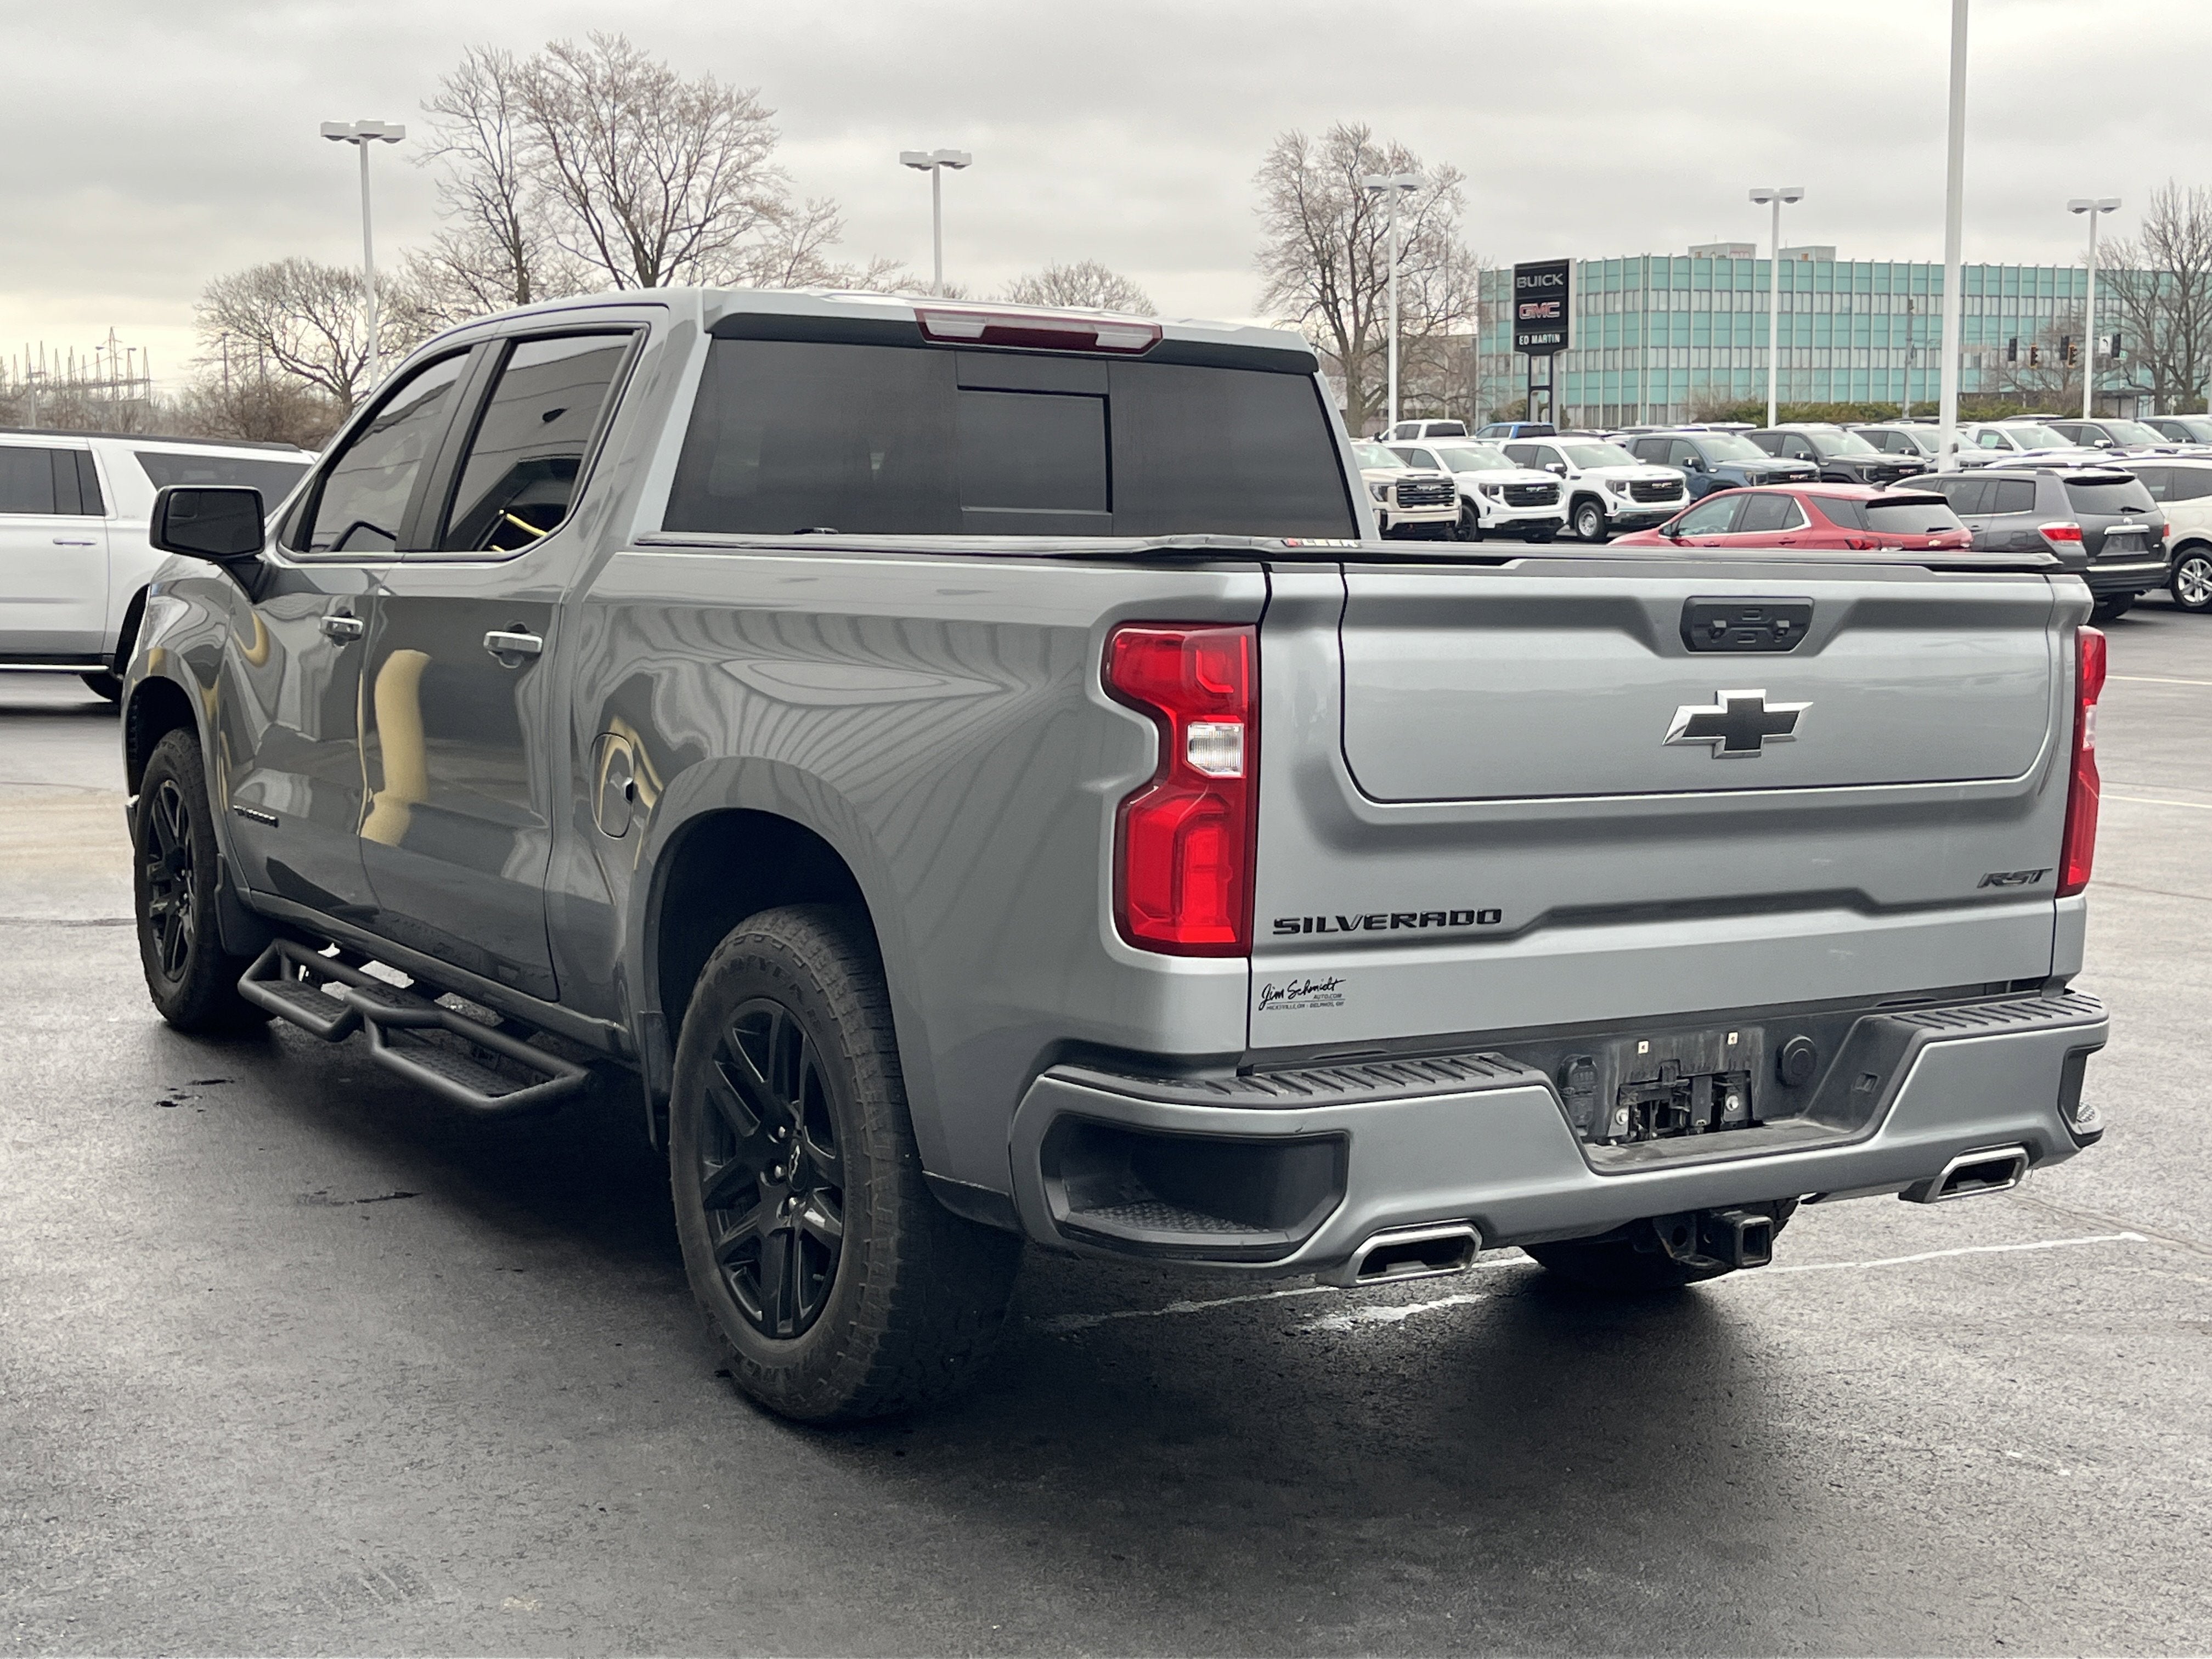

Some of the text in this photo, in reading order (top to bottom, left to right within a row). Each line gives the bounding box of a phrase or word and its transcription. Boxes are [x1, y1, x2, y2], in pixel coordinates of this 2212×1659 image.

[1516, 273, 1564, 289] BUICK
[1519, 301, 1560, 320] GMC
[1519, 333, 1560, 345] ED MARTIN
[1976, 867, 2053, 889] RST
[1273, 908, 1502, 935] SILVERADO
[1258, 976, 1346, 1011] Jim Schmidt
